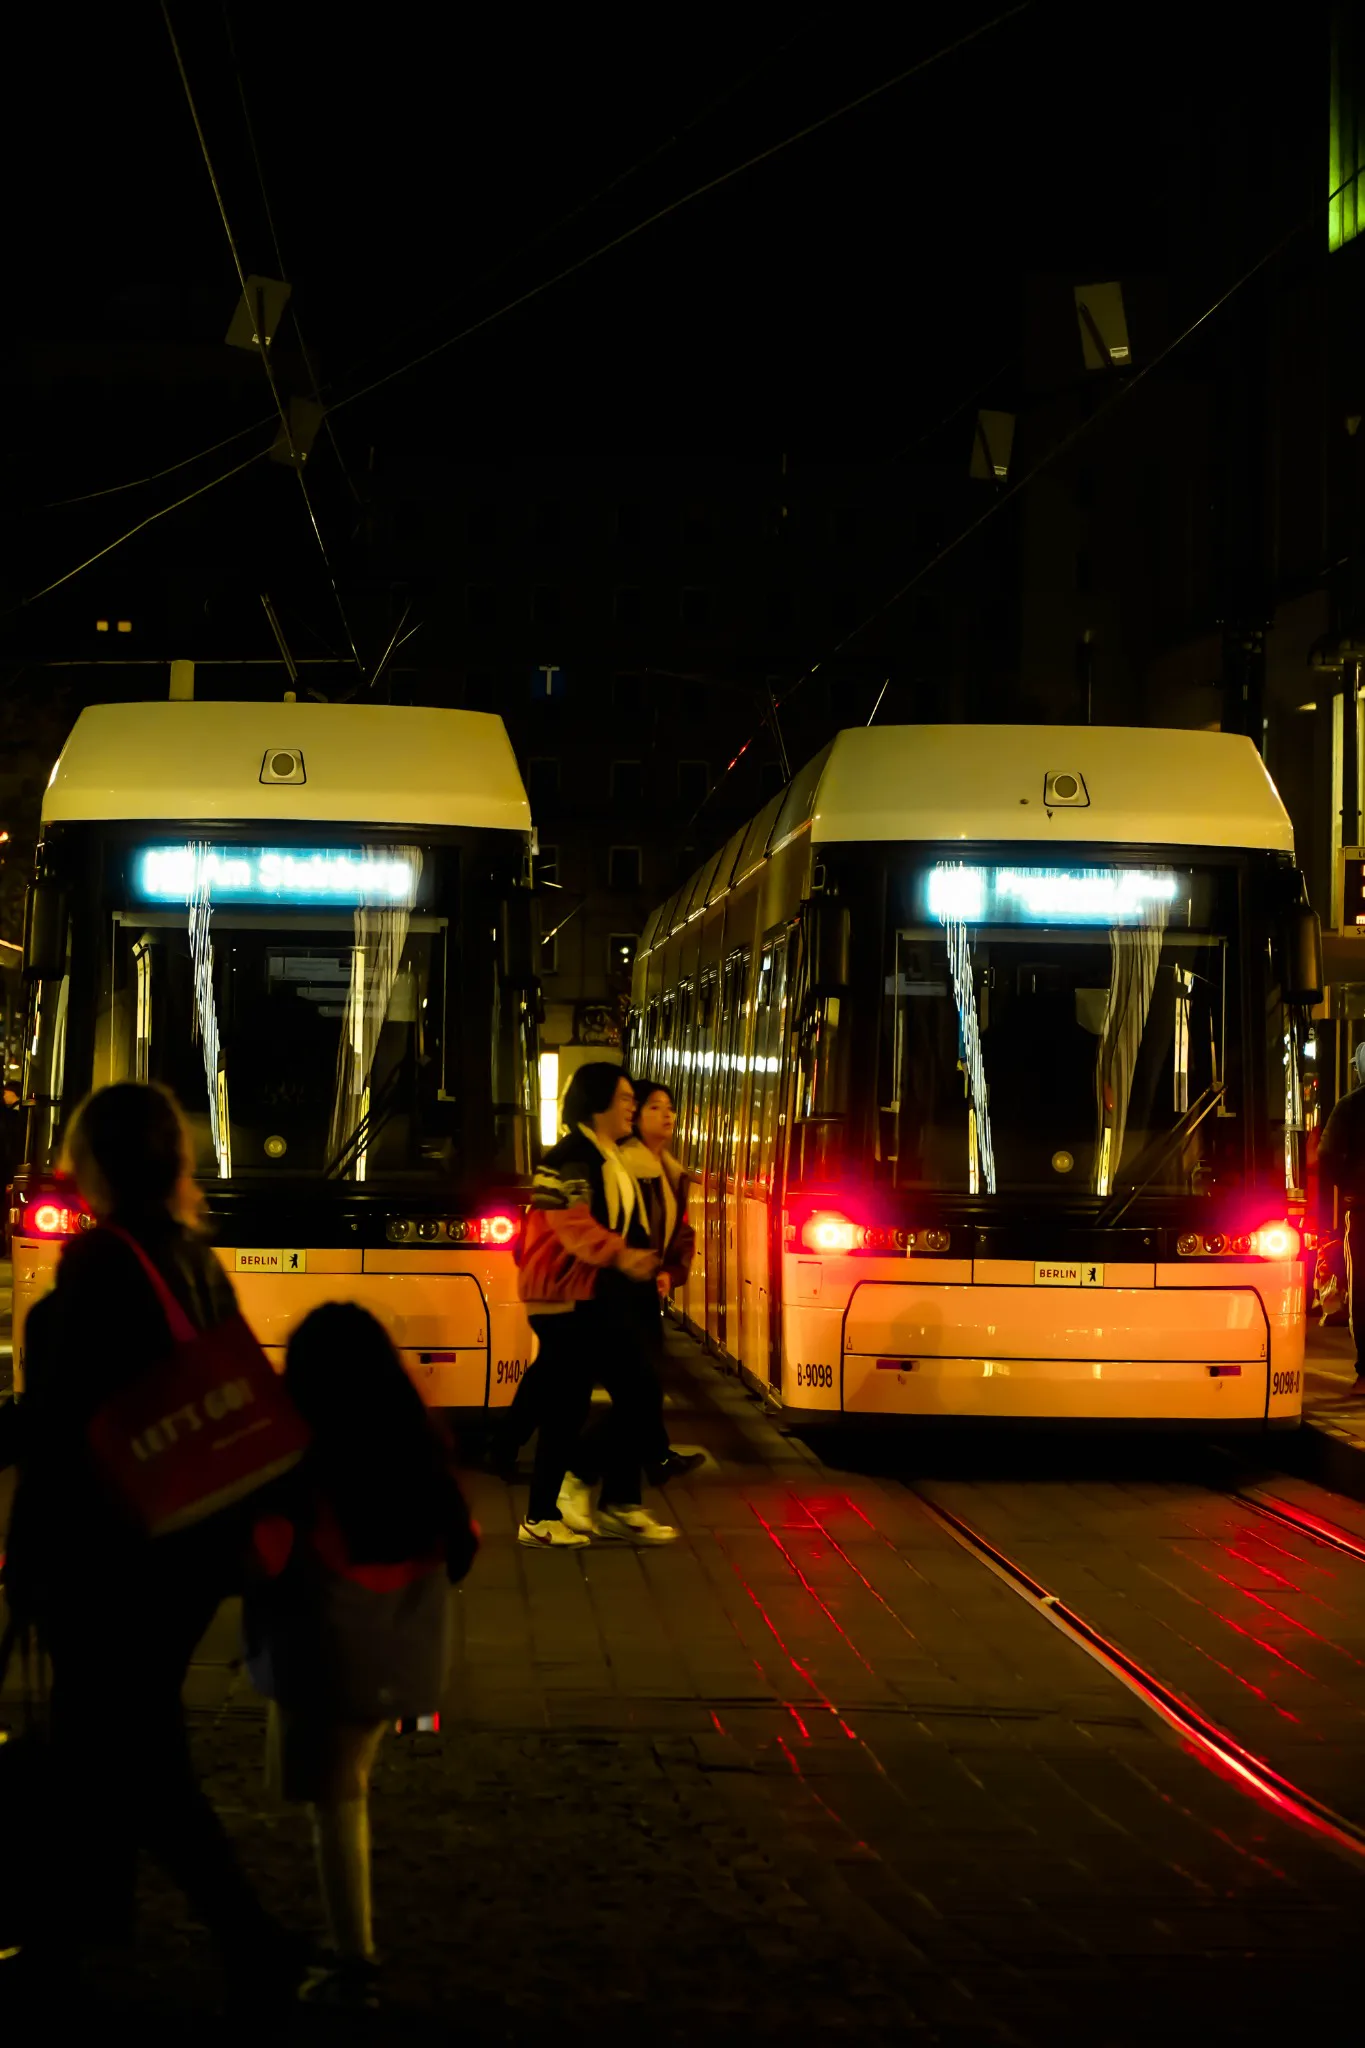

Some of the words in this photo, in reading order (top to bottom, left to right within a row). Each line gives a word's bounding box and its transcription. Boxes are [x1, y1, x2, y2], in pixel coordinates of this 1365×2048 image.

[538, 664, 561, 695] T
[240, 1256, 278, 1265] BERLIN
[1039, 1269, 1076, 1279] BERLIN
[797, 1363, 833, 1388] B-9098
